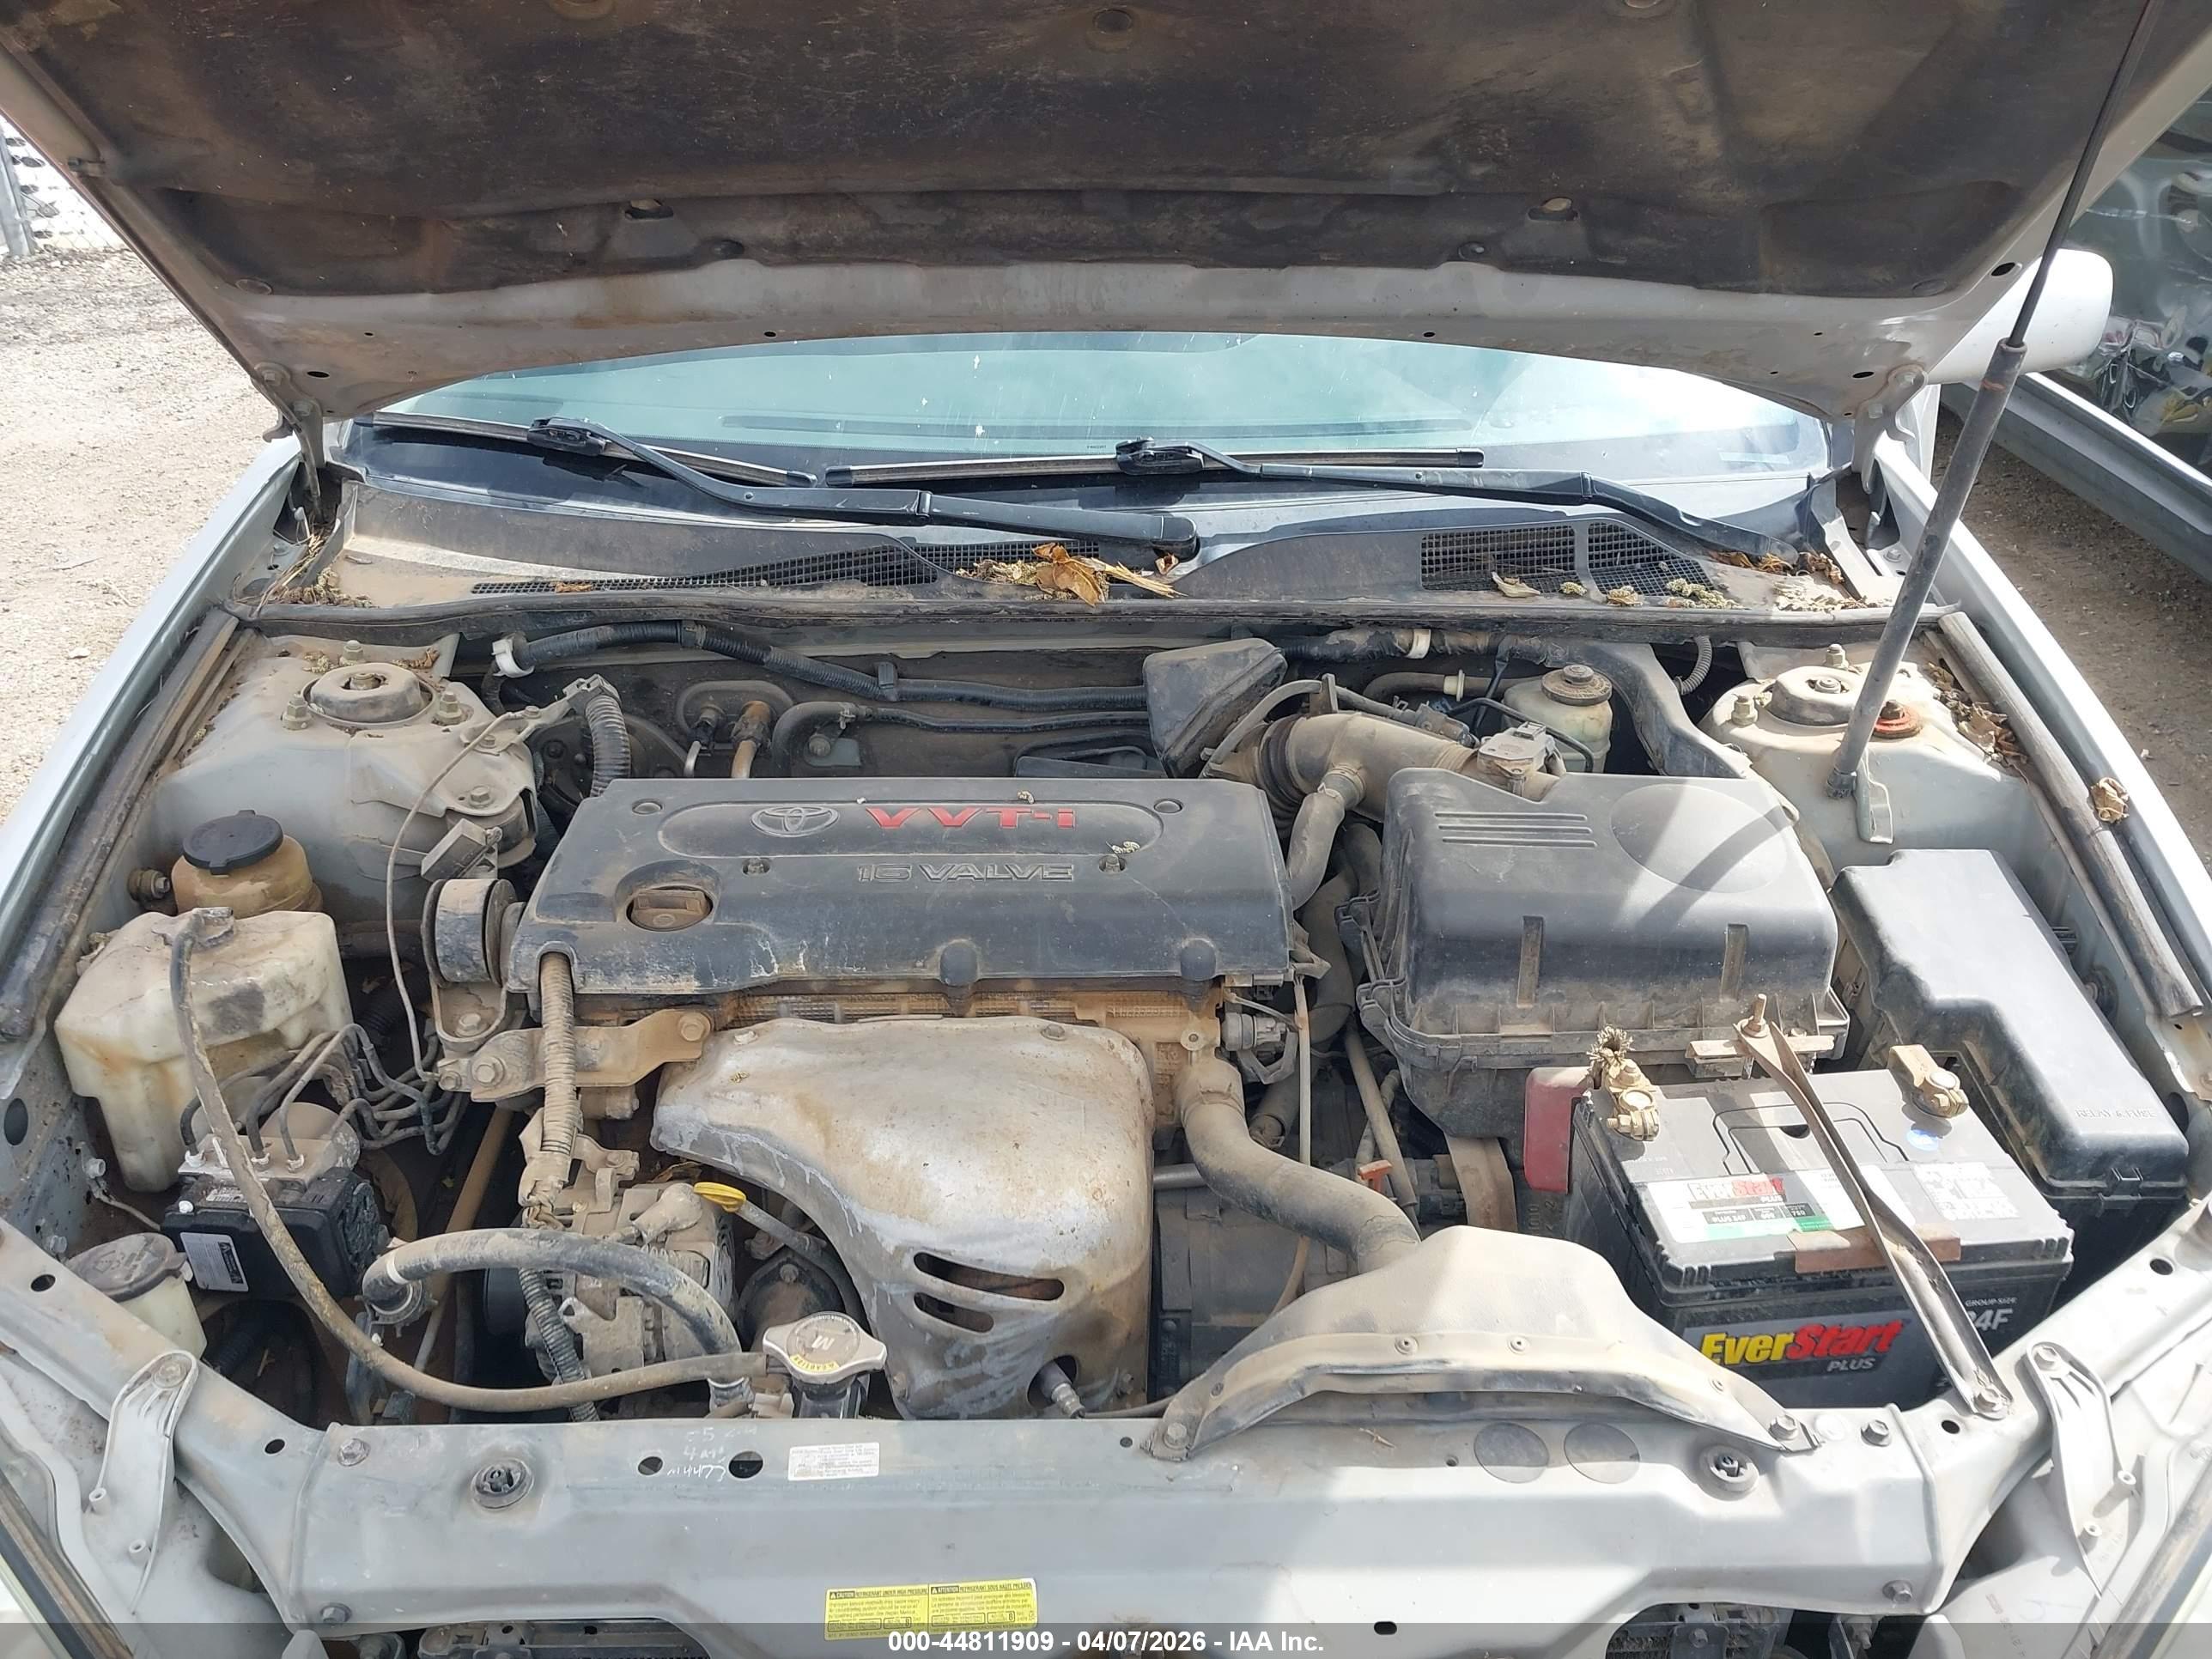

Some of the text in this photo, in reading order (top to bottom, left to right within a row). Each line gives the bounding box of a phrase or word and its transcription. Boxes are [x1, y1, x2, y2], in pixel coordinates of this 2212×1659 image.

[858, 863, 1074, 882] 16 VALVE
[1687, 1176, 1786, 1201] EverStart
[1700, 1318, 1905, 1366] EverStart
[1826, 1357, 1877, 1372] PLUS
